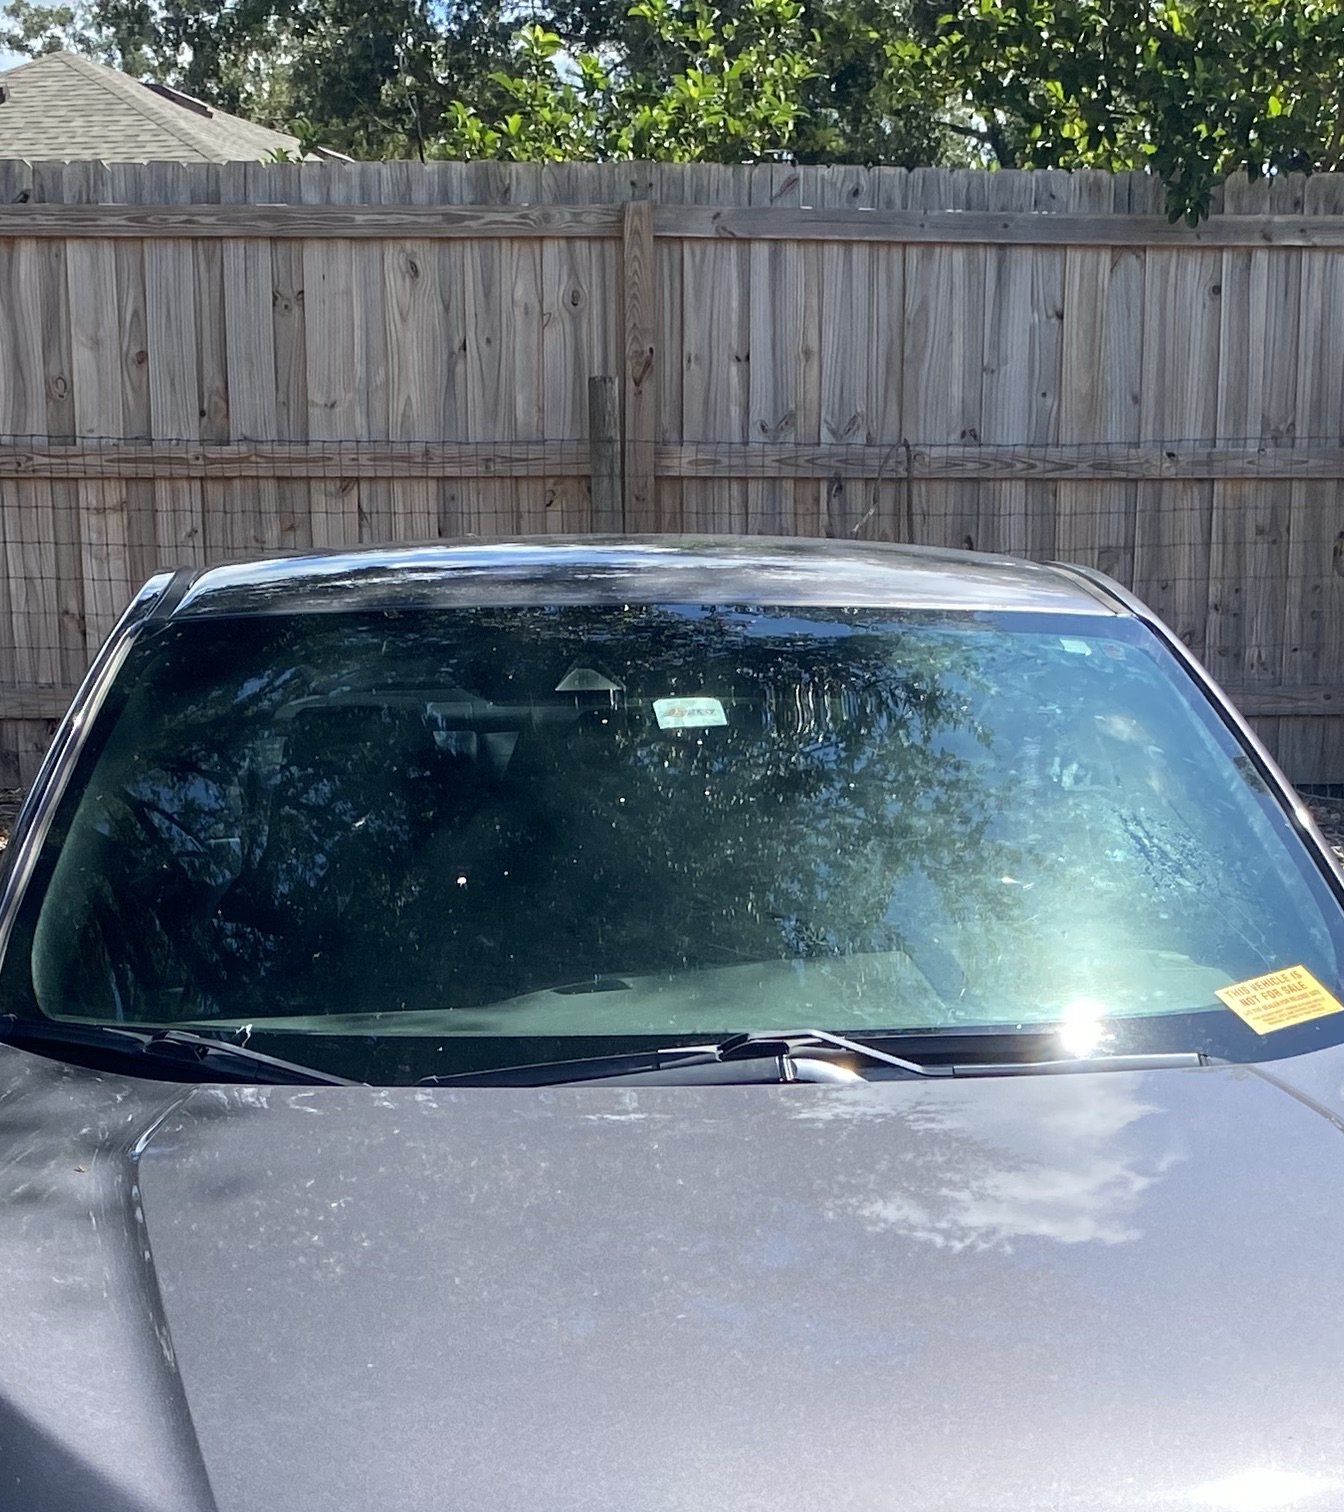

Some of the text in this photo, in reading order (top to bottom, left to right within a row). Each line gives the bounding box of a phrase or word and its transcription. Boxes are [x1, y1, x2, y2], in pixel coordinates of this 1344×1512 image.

[1224, 970, 1303, 1000] THIS VEHICLE IS
[1238, 993, 1262, 1007] NOT
[1260, 988, 1283, 1001] FOR
[1281, 981, 1308, 995] SALE
